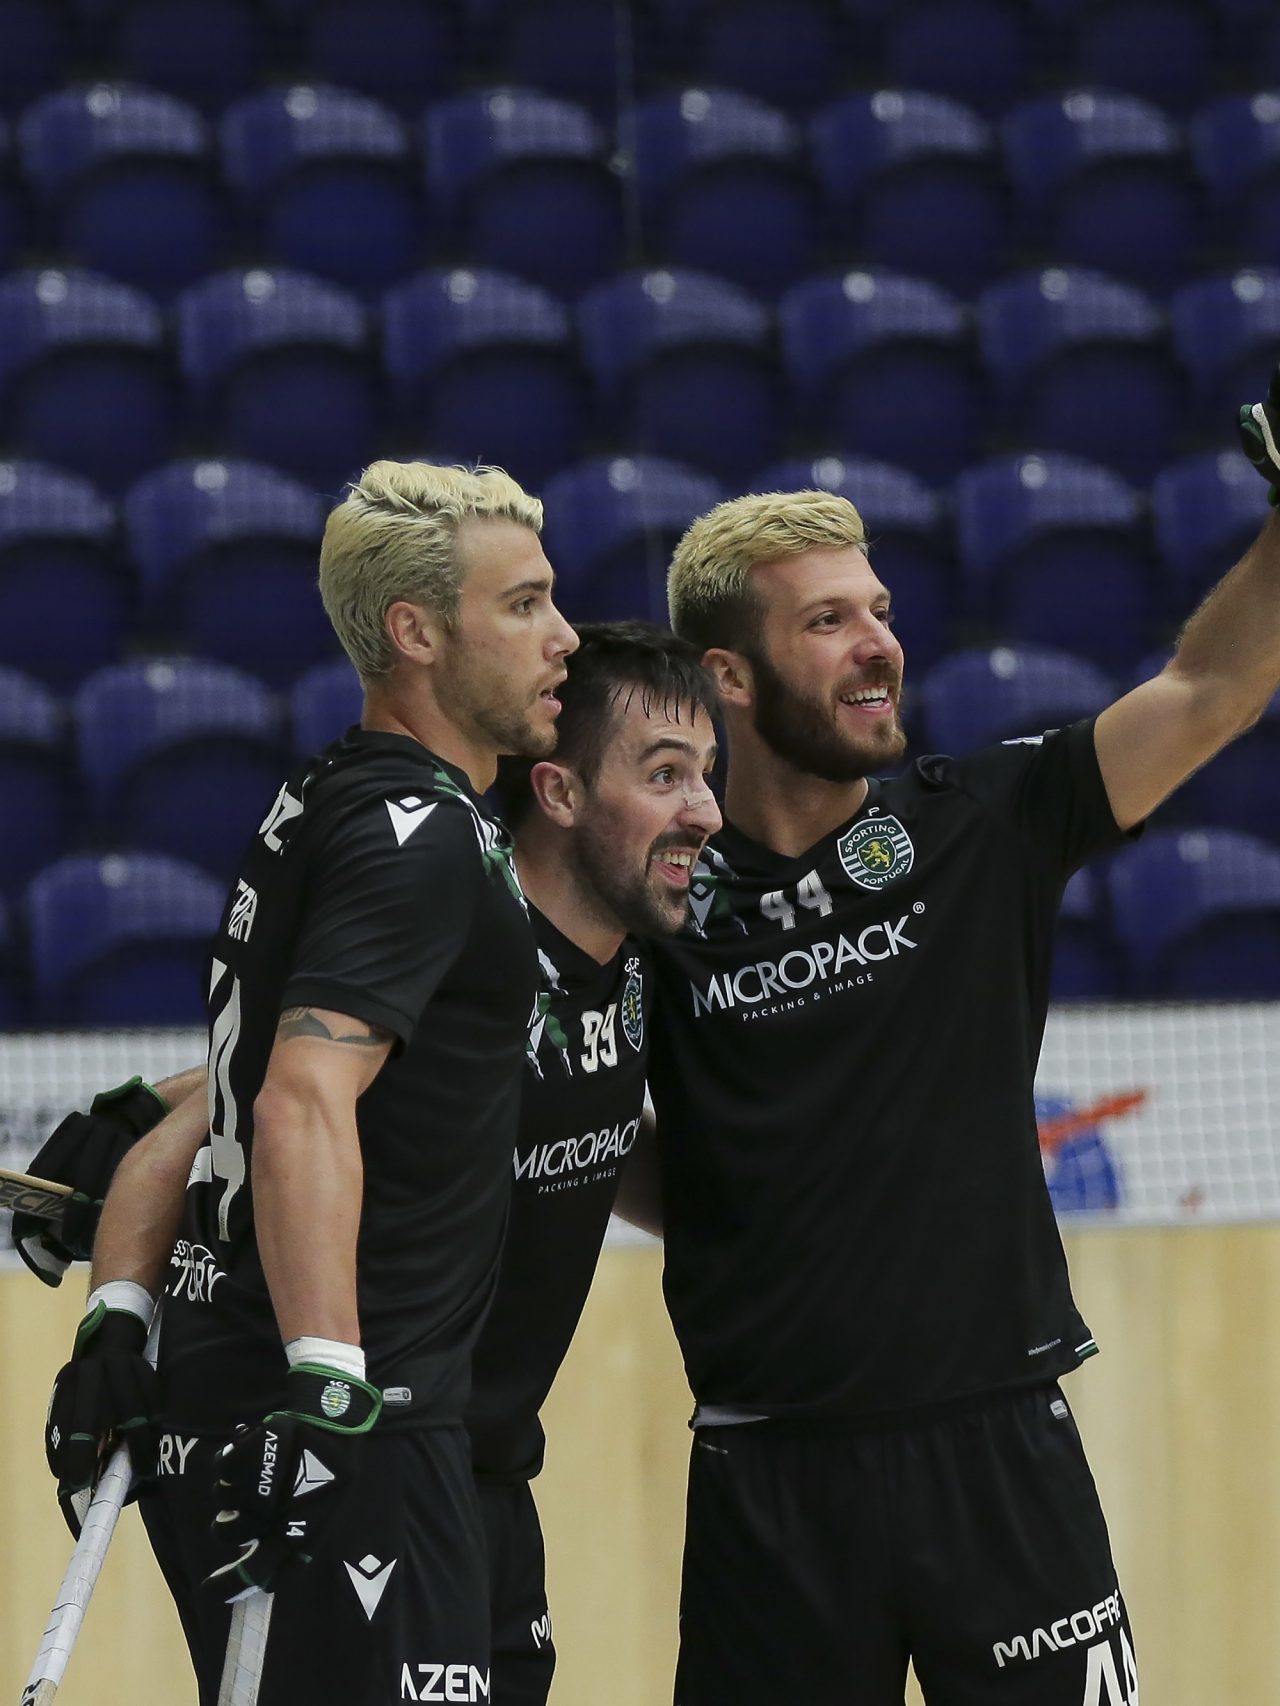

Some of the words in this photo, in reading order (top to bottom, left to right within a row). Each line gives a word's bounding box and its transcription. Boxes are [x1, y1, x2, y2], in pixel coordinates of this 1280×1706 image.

[844, 824, 897, 853] SPORTING
[863, 858, 910, 885] PORTUGAL
[759, 868, 834, 932] 44
[689, 914, 919, 1018] MICROPACK
[742, 997, 805, 1022] PACKING
[813, 991, 821, 1001] &
[828, 972, 875, 995] IMAGE
[580, 1003, 619, 1074] 99
[538, 1178, 580, 1195] PACKING
[258, 1430, 279, 1497] AZEMAD
[286, 1520, 307, 1537] 14
